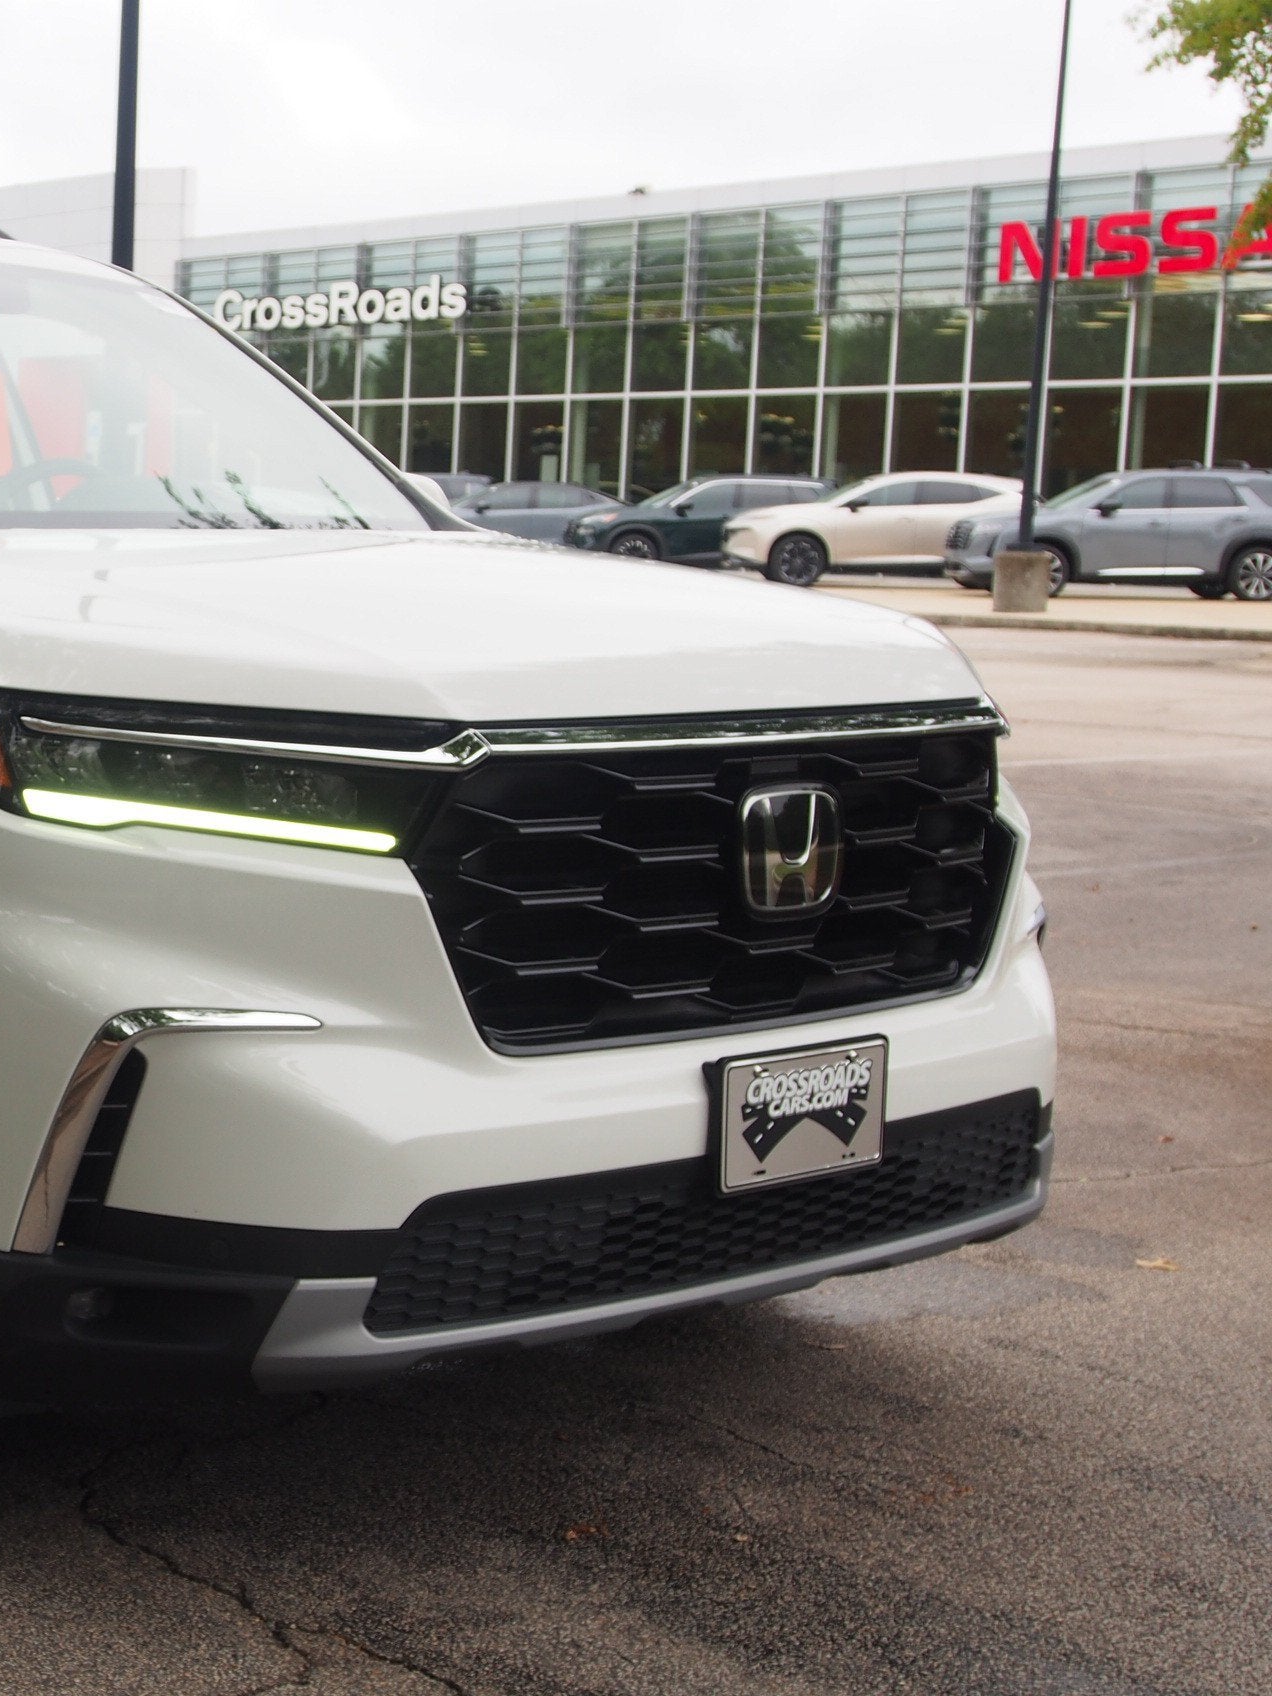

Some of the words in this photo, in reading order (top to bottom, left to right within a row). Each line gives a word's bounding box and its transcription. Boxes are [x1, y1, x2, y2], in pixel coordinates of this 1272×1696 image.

[213, 274, 468, 332] CrossRoads
[746, 1058, 873, 1108] CROSSROADS
[768, 1086, 850, 1118] CARS.COM
